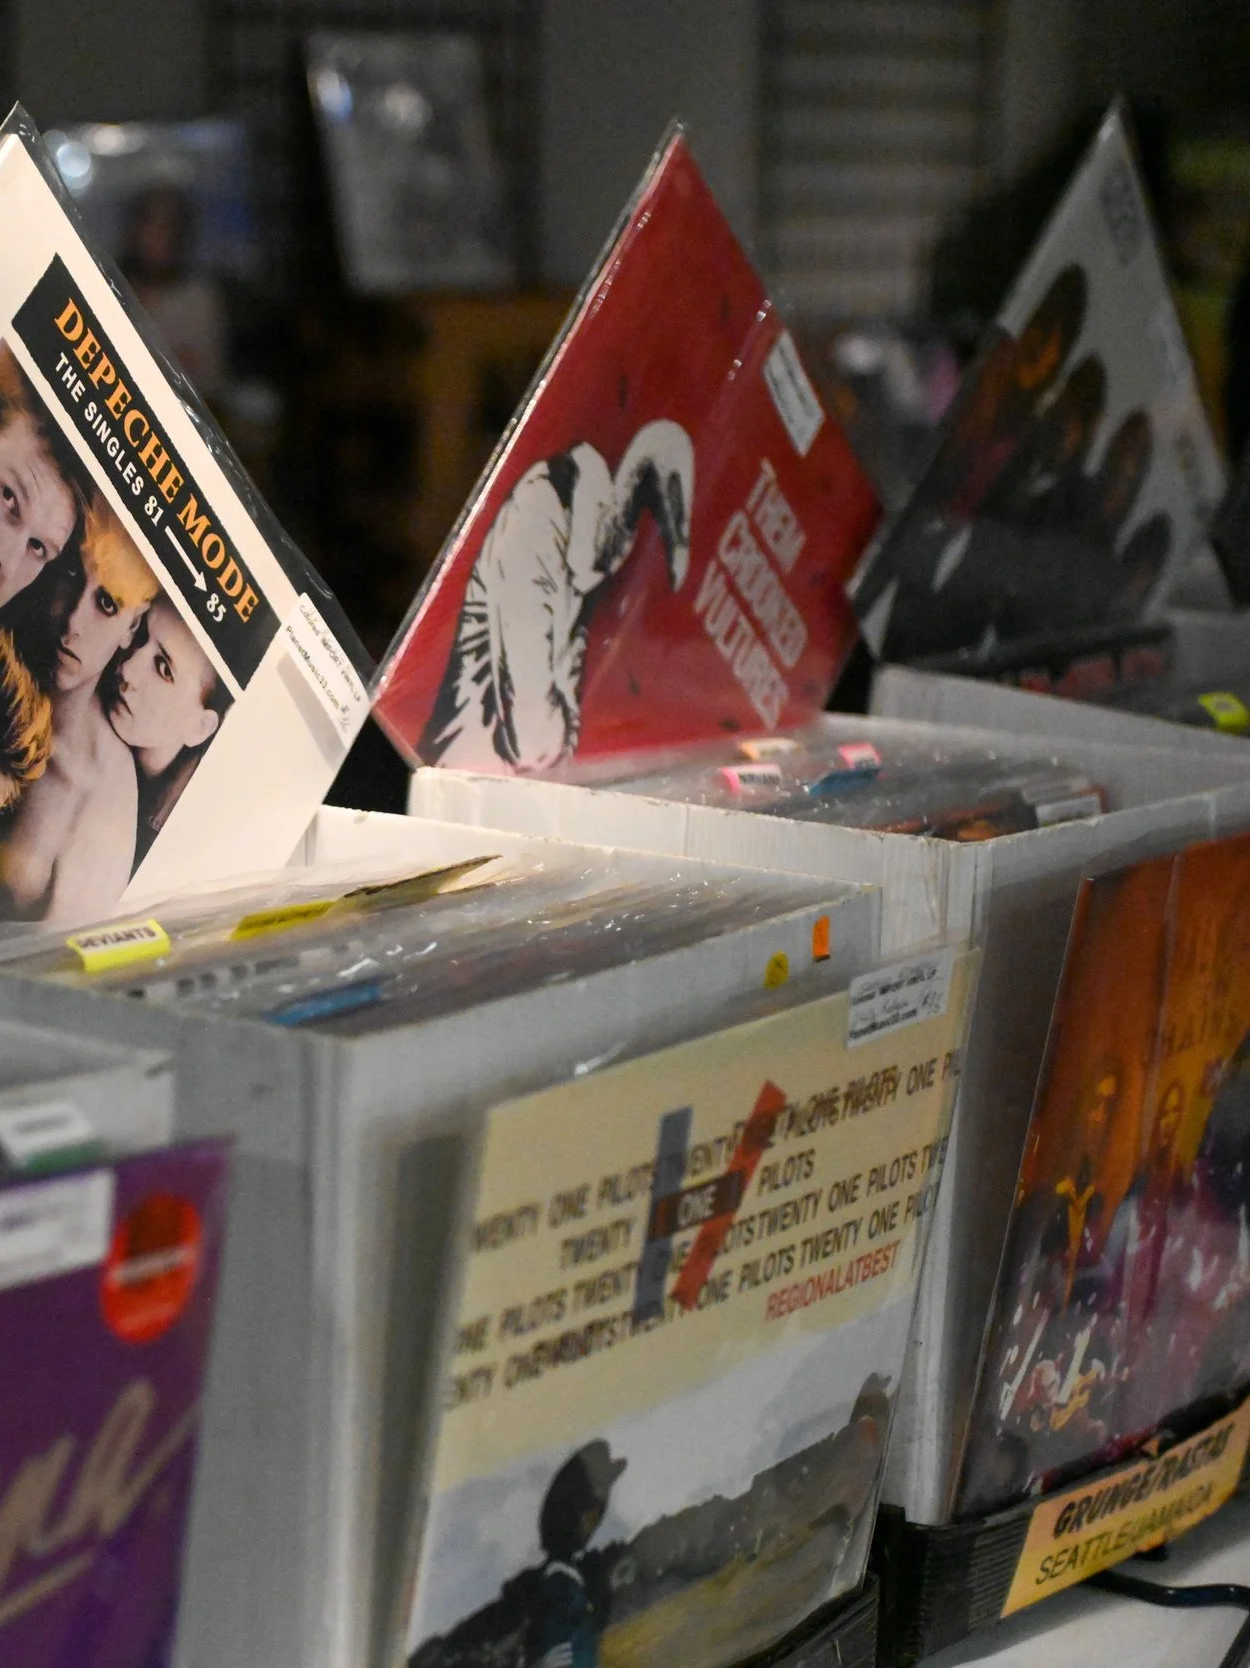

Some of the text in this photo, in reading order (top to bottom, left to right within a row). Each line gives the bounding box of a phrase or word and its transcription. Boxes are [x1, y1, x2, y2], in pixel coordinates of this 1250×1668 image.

[54, 297, 260, 622] DEPECHE MODE
[55, 352, 227, 622] THE SINGLES 81 85
[746, 456, 807, 576] THEM
[693, 558, 792, 733] VULTURES
[717, 508, 808, 671] CROOKED
[906, 1057, 939, 1097] ONE
[559, 1147, 816, 1270] TWENTY ONE PILOTS
[737, 1244, 795, 1292] PILOTS
[798, 1217, 864, 1270] TWENTY
[867, 1202, 900, 1240] ONE
[754, 1187, 823, 1241] TWENTY
[827, 1172, 863, 1213] ONE
[865, 1150, 918, 1198] PILOTS
[764, 1240, 902, 1322] REGIONALATBEST
